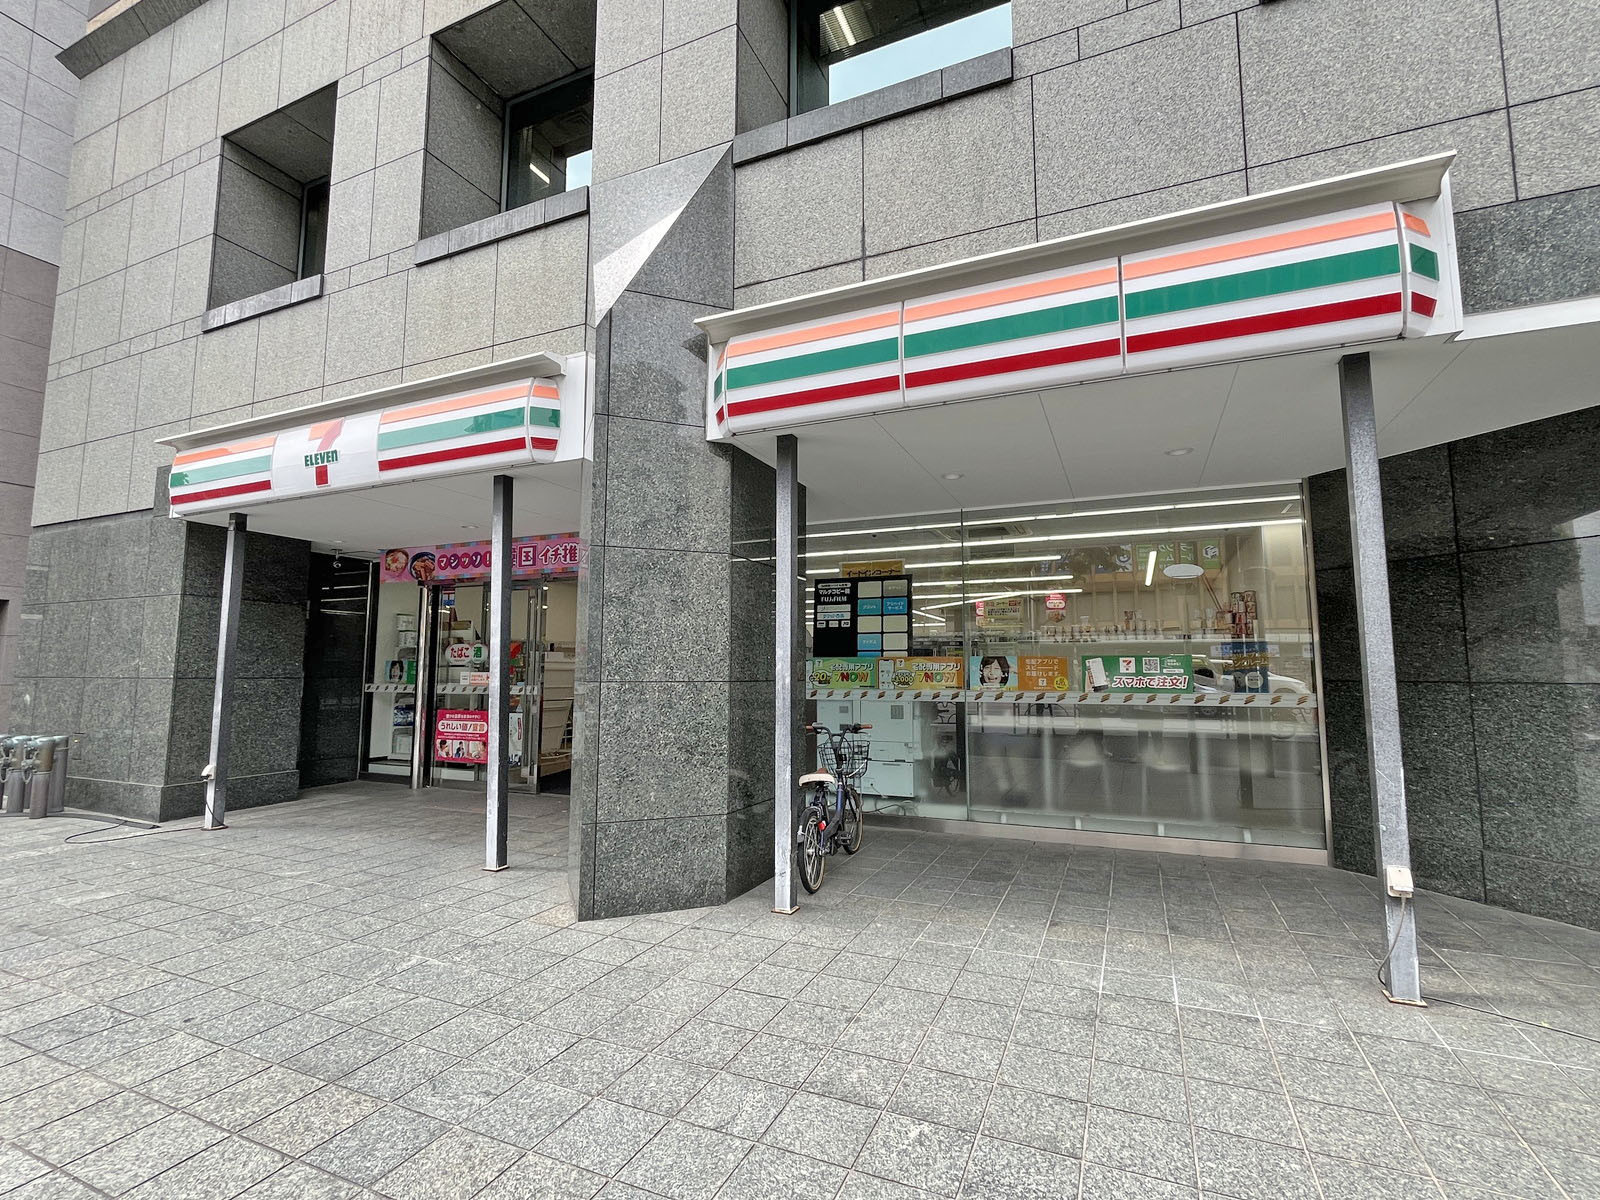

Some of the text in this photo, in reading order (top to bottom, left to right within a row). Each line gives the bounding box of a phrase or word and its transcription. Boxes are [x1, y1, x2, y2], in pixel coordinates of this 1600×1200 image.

[512, 543, 579, 568] 国イチ推
[451, 647, 470, 658] たばこ
[474, 647, 482, 658] 酒
[834, 672, 869, 683] 7NOW
[917, 672, 956, 683] 7NOW
[1112, 675, 1189, 689] スマホで注文!
